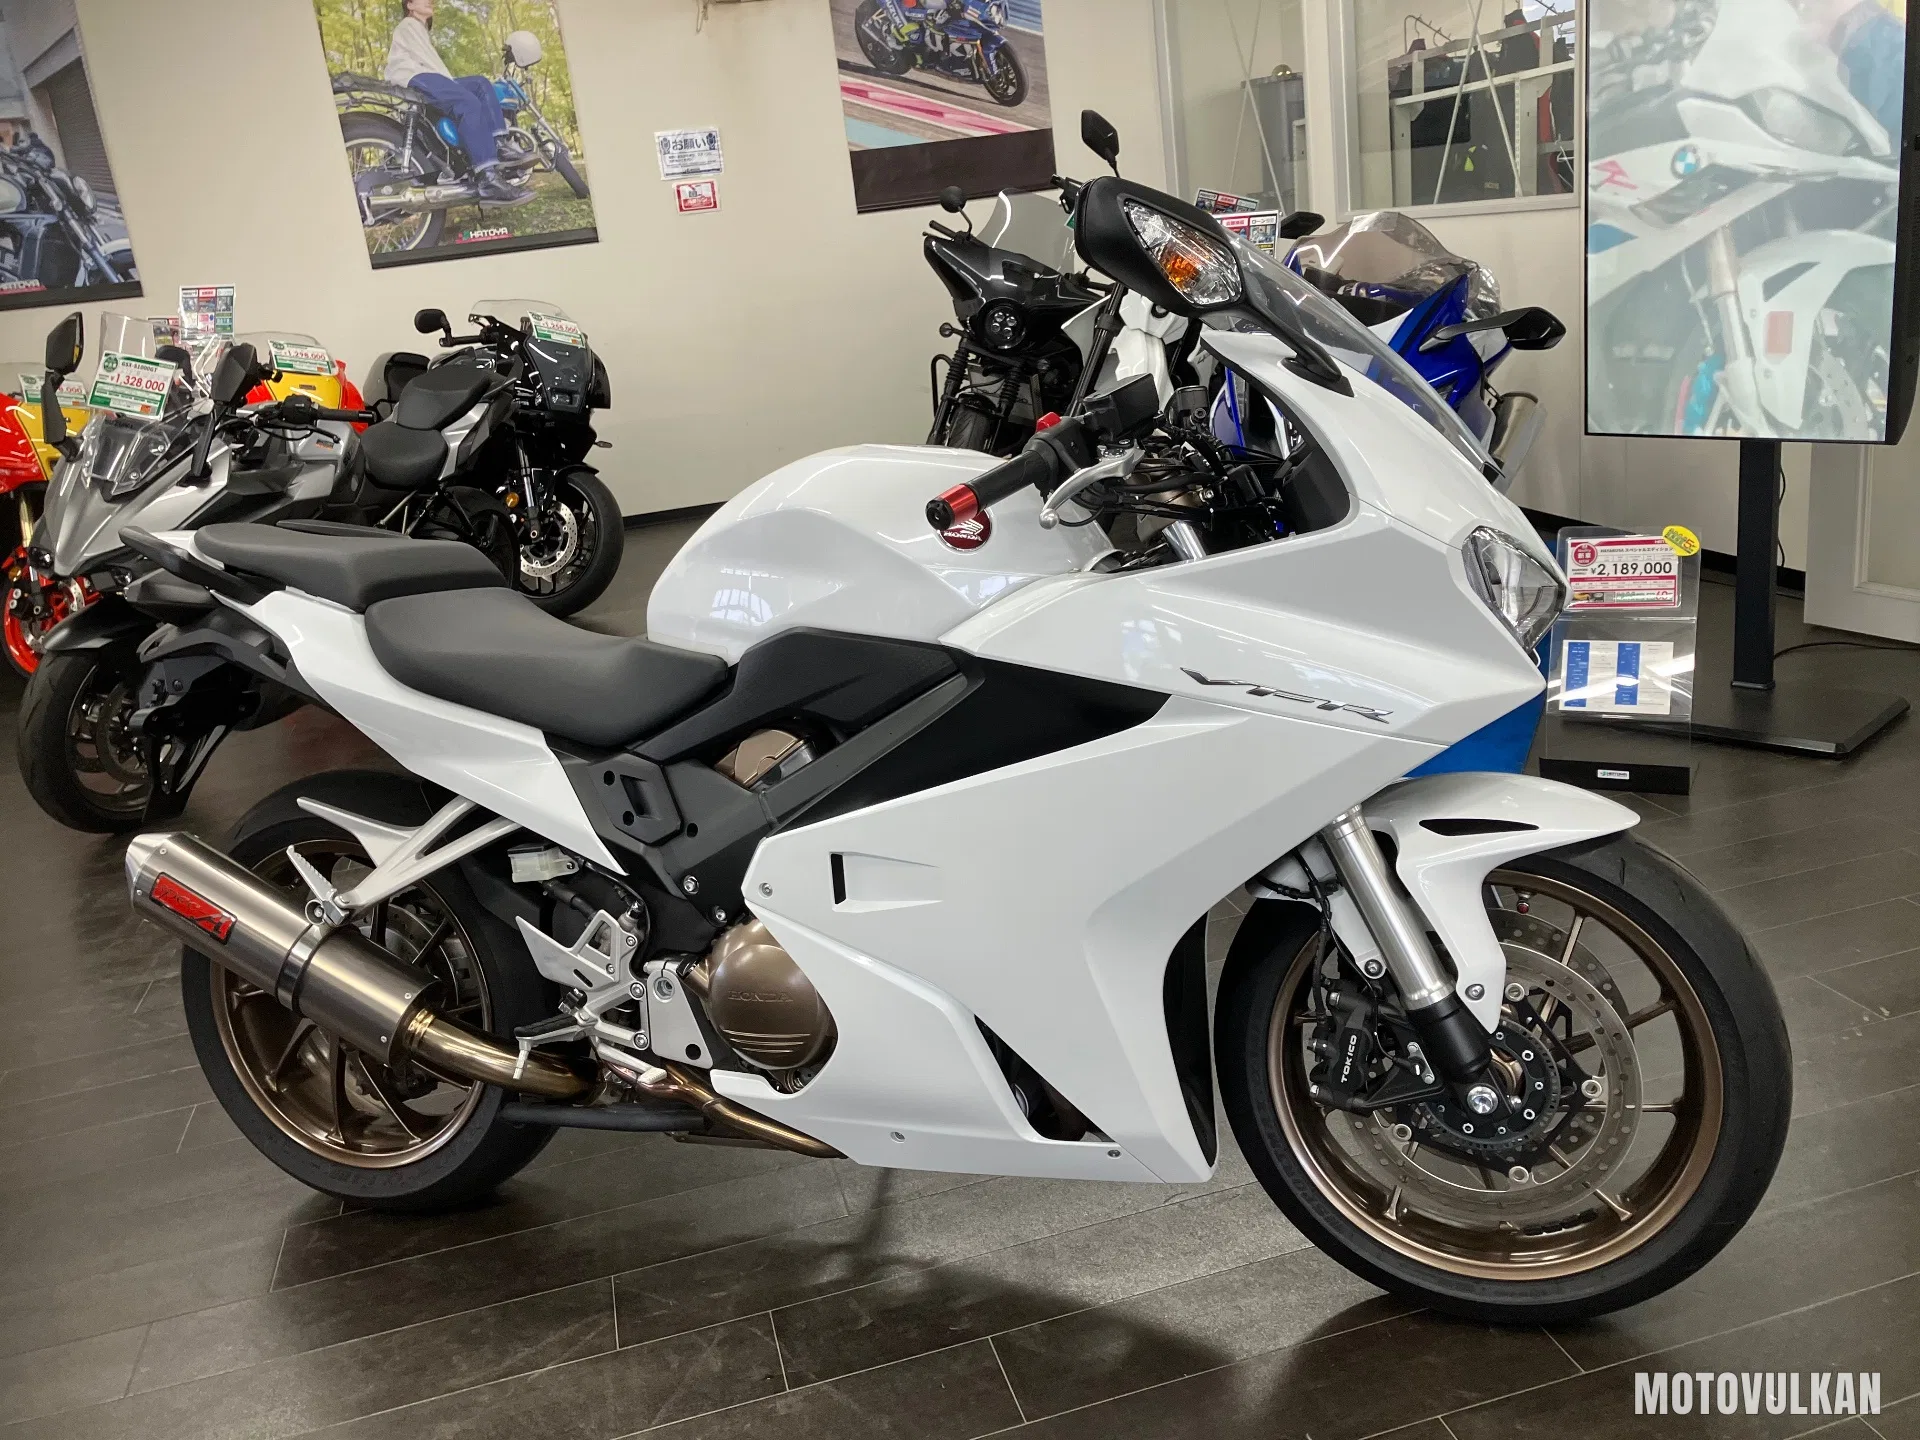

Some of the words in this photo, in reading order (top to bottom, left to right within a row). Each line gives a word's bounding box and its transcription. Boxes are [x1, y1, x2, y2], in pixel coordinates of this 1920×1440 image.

[672, 138, 706, 151] お願い
[469, 227, 508, 238] HATOYA
[1591, 561, 1673, 577] ¥2,189,000
[1180, 667, 1394, 724] VFR
[728, 990, 794, 1003] HONDA
[1341, 1034, 1357, 1083] TOKICO
